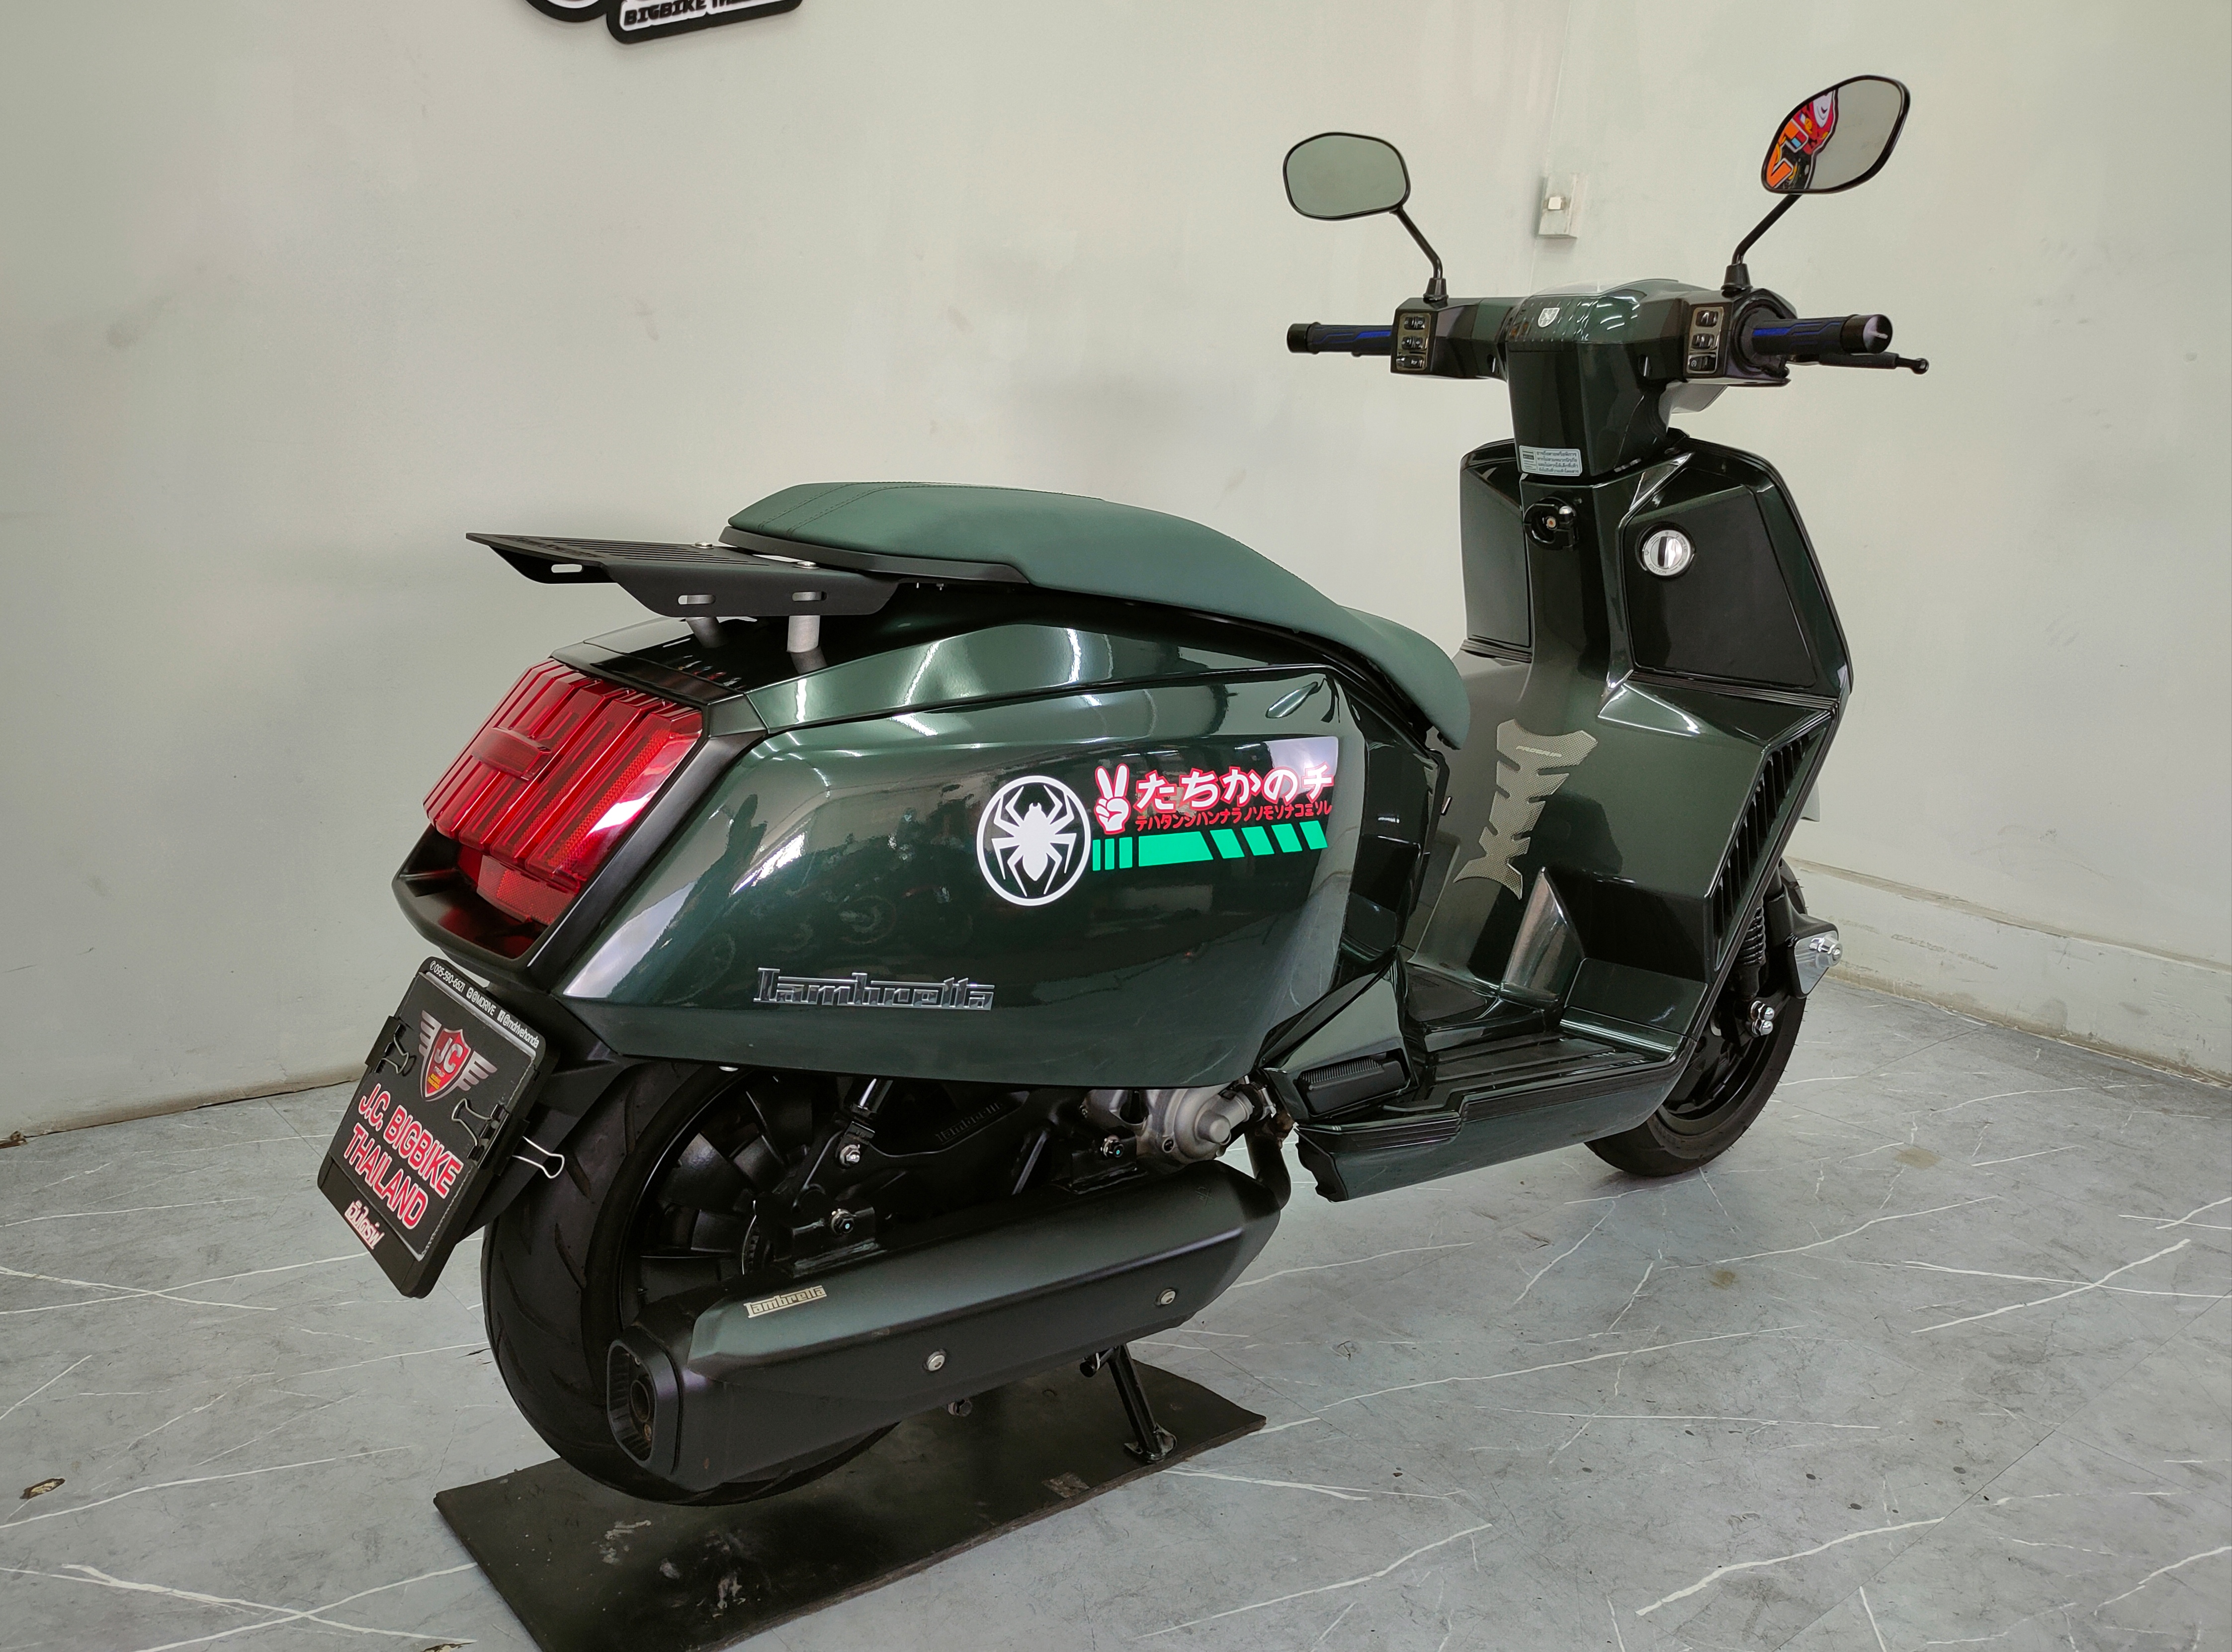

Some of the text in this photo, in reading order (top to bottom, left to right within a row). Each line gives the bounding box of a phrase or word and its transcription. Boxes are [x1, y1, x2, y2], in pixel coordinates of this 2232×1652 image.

[624, 0, 707, 26] BIGBIKE
[1648, 563, 1667, 574] IGNITION
[434, 963, 466, 993] 095-590-6621
[434, 1037, 463, 1073] JC
[358, 1083, 464, 1199] J.C. BIGBIKE
[344, 1126, 429, 1230] THAILAND
